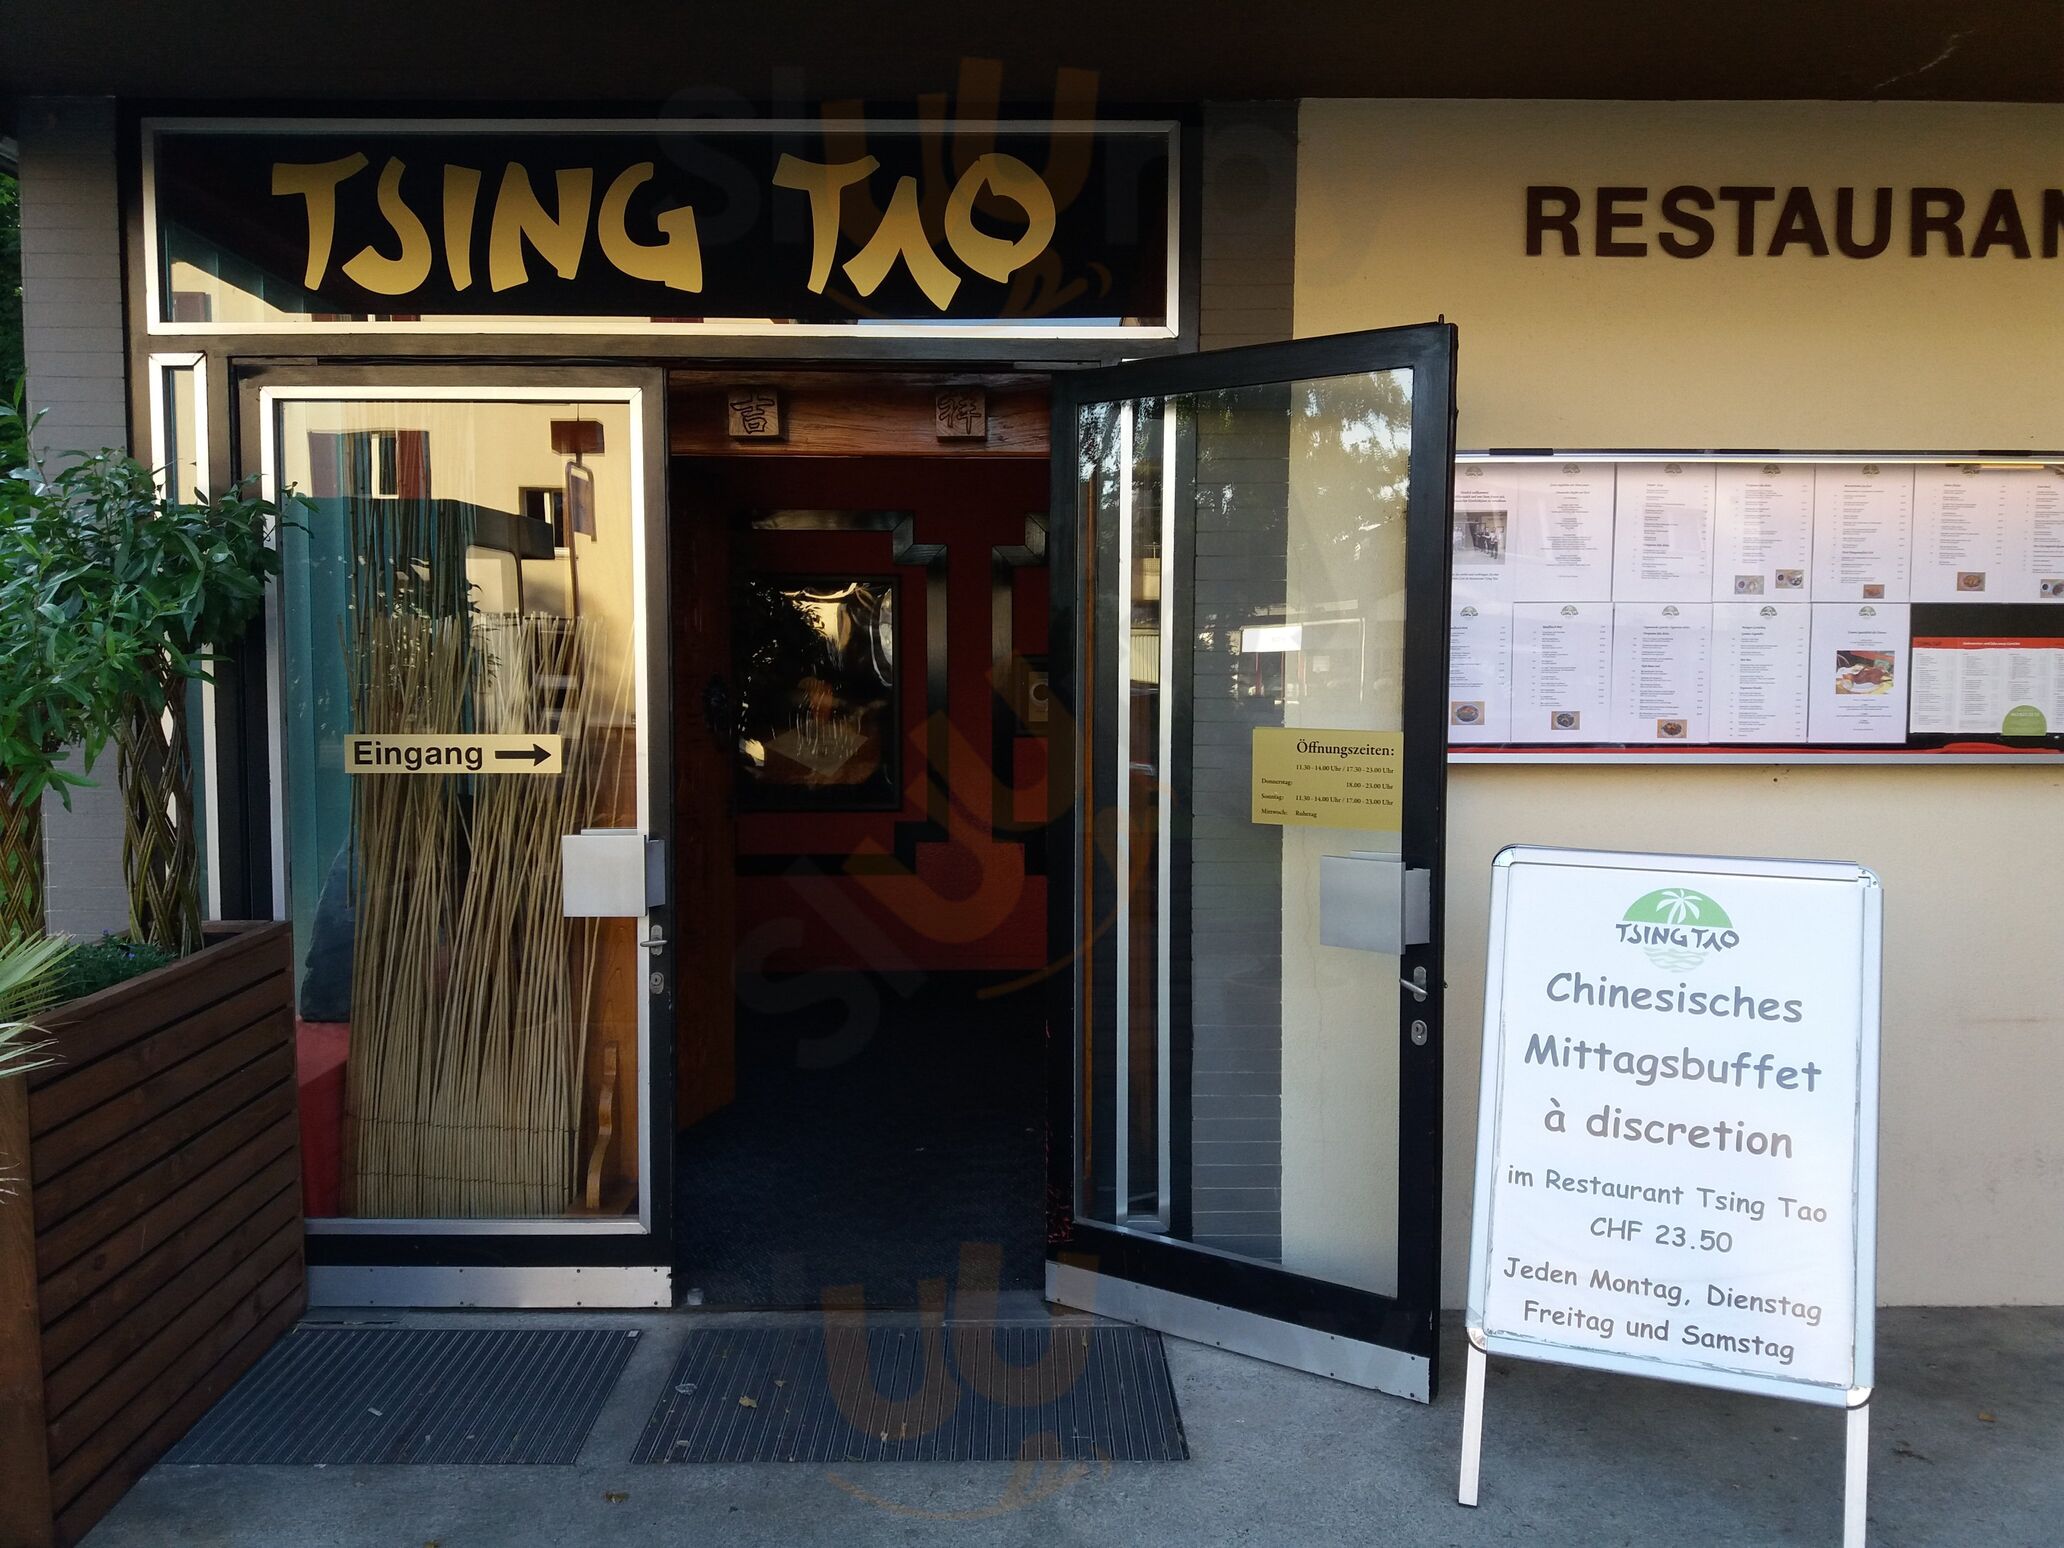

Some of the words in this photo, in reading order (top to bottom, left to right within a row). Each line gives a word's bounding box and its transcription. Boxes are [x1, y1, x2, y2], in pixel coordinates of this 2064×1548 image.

[271, 153, 702, 296] TSING
[772, 152, 1058, 311] TAO
[730, 390, 775, 434] 吉
[353, 741, 483, 771] Eingang
[1297, 738, 1395, 759] Öffnungszeiten:
[1615, 923, 1688, 947] TSING
[1691, 927, 1740, 951] TAO
[1546, 971, 1803, 1023] Chinesisches
[1524, 1033, 1822, 1092] Mittagsbuffet
[1544, 1098, 1567, 1133] à
[1585, 1104, 1793, 1159] discretion
[1508, 1164, 1534, 1188] im
[1545, 1168, 1685, 1206] Restaurant
[1696, 1186, 1765, 1221] Tsing
[1778, 1196, 1828, 1223] Tao
[1590, 1216, 1643, 1242] CHF
[1655, 1224, 1734, 1253] 23.50
[1503, 1256, 1578, 1286] Jeden
[1589, 1268, 1691, 1307] Montag,
[1707, 1283, 1823, 1326] Dienstag
[1524, 1299, 1615, 1338] Freitag
[1626, 1319, 1670, 1342] und
[1681, 1324, 1795, 1366] Samstag
